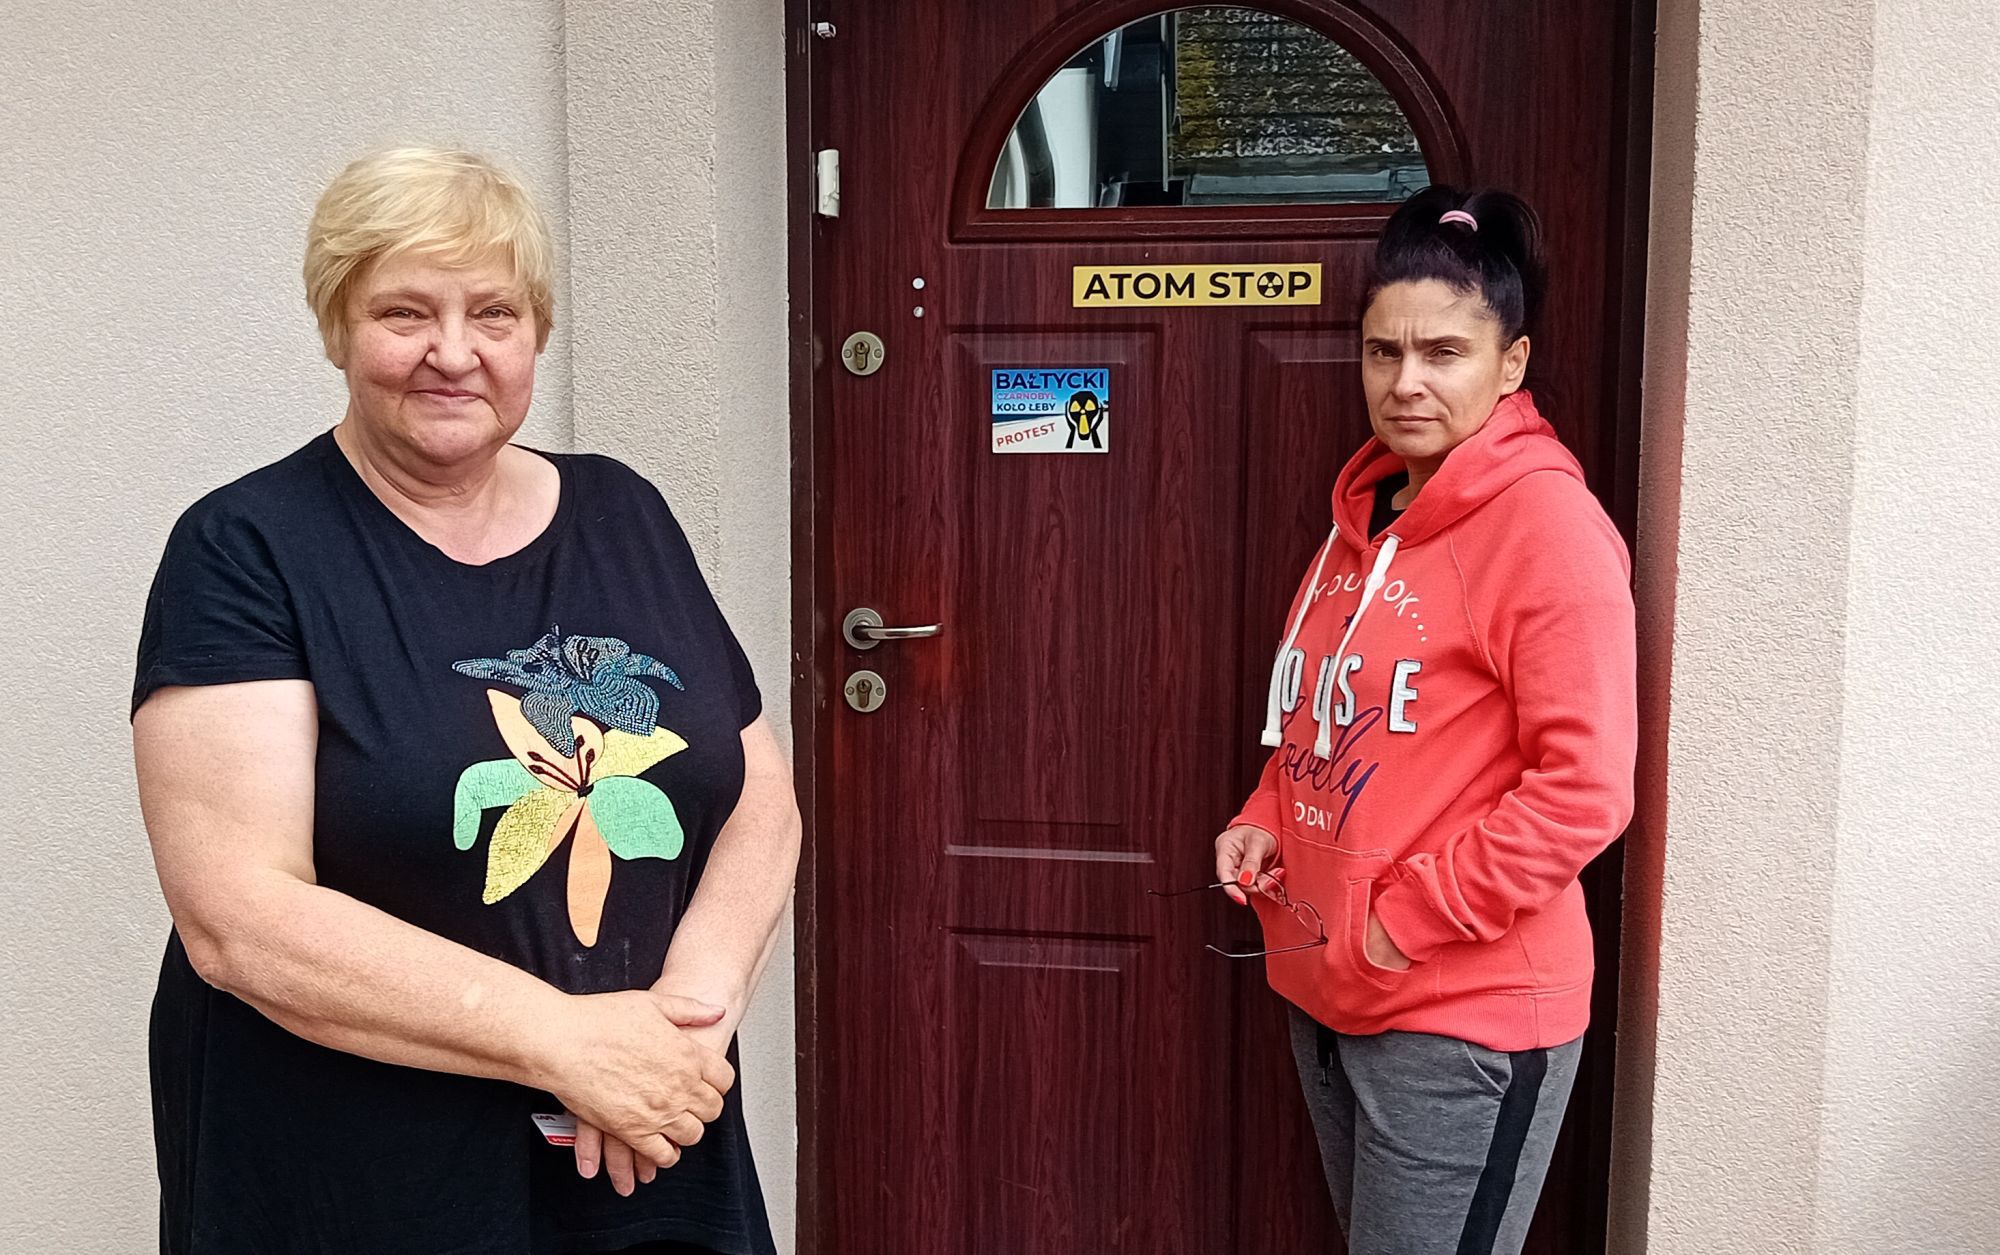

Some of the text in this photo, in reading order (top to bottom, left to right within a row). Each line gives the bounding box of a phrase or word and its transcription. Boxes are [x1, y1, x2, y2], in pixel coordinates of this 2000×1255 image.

[1083, 272, 1195, 299] ATOM
[996, 372, 1104, 389] BAŁTYCKI
[996, 392, 1056, 400] CZARNOBYL
[996, 402, 1056, 411] KOŁO ŁEBY
[996, 422, 1056, 447] PROTEST
[1292, 799, 1333, 831] ODAY
